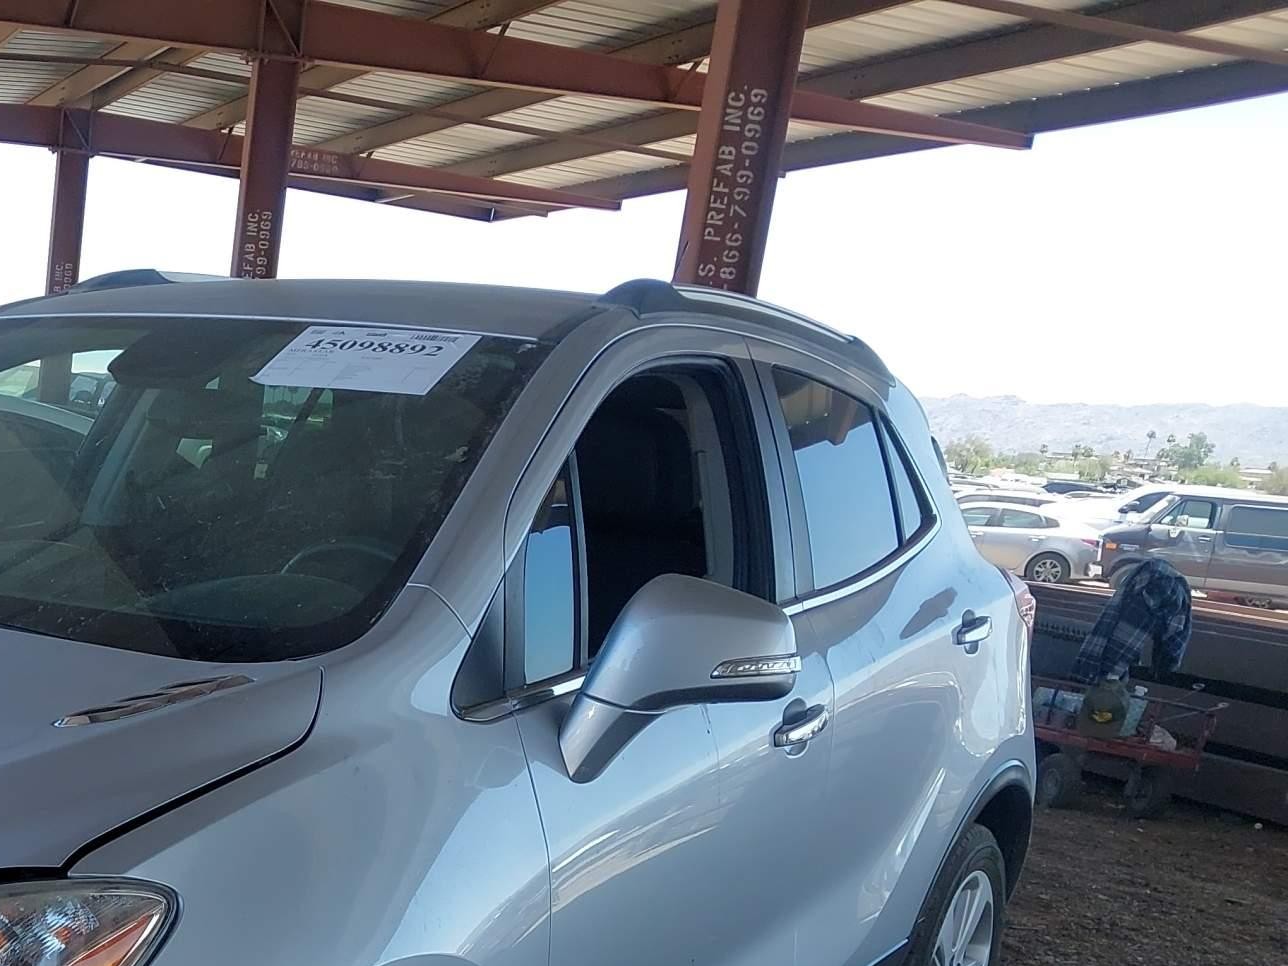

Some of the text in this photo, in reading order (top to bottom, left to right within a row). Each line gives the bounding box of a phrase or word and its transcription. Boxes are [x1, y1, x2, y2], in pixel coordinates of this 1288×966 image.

[703, 145, 736, 241] PREFAB
[723, 84, 748, 131] INC.
[246, 209, 260, 236] INC.
[255, 211, 273, 279] 99-0969
[305, 337, 445, 357] 45098892
